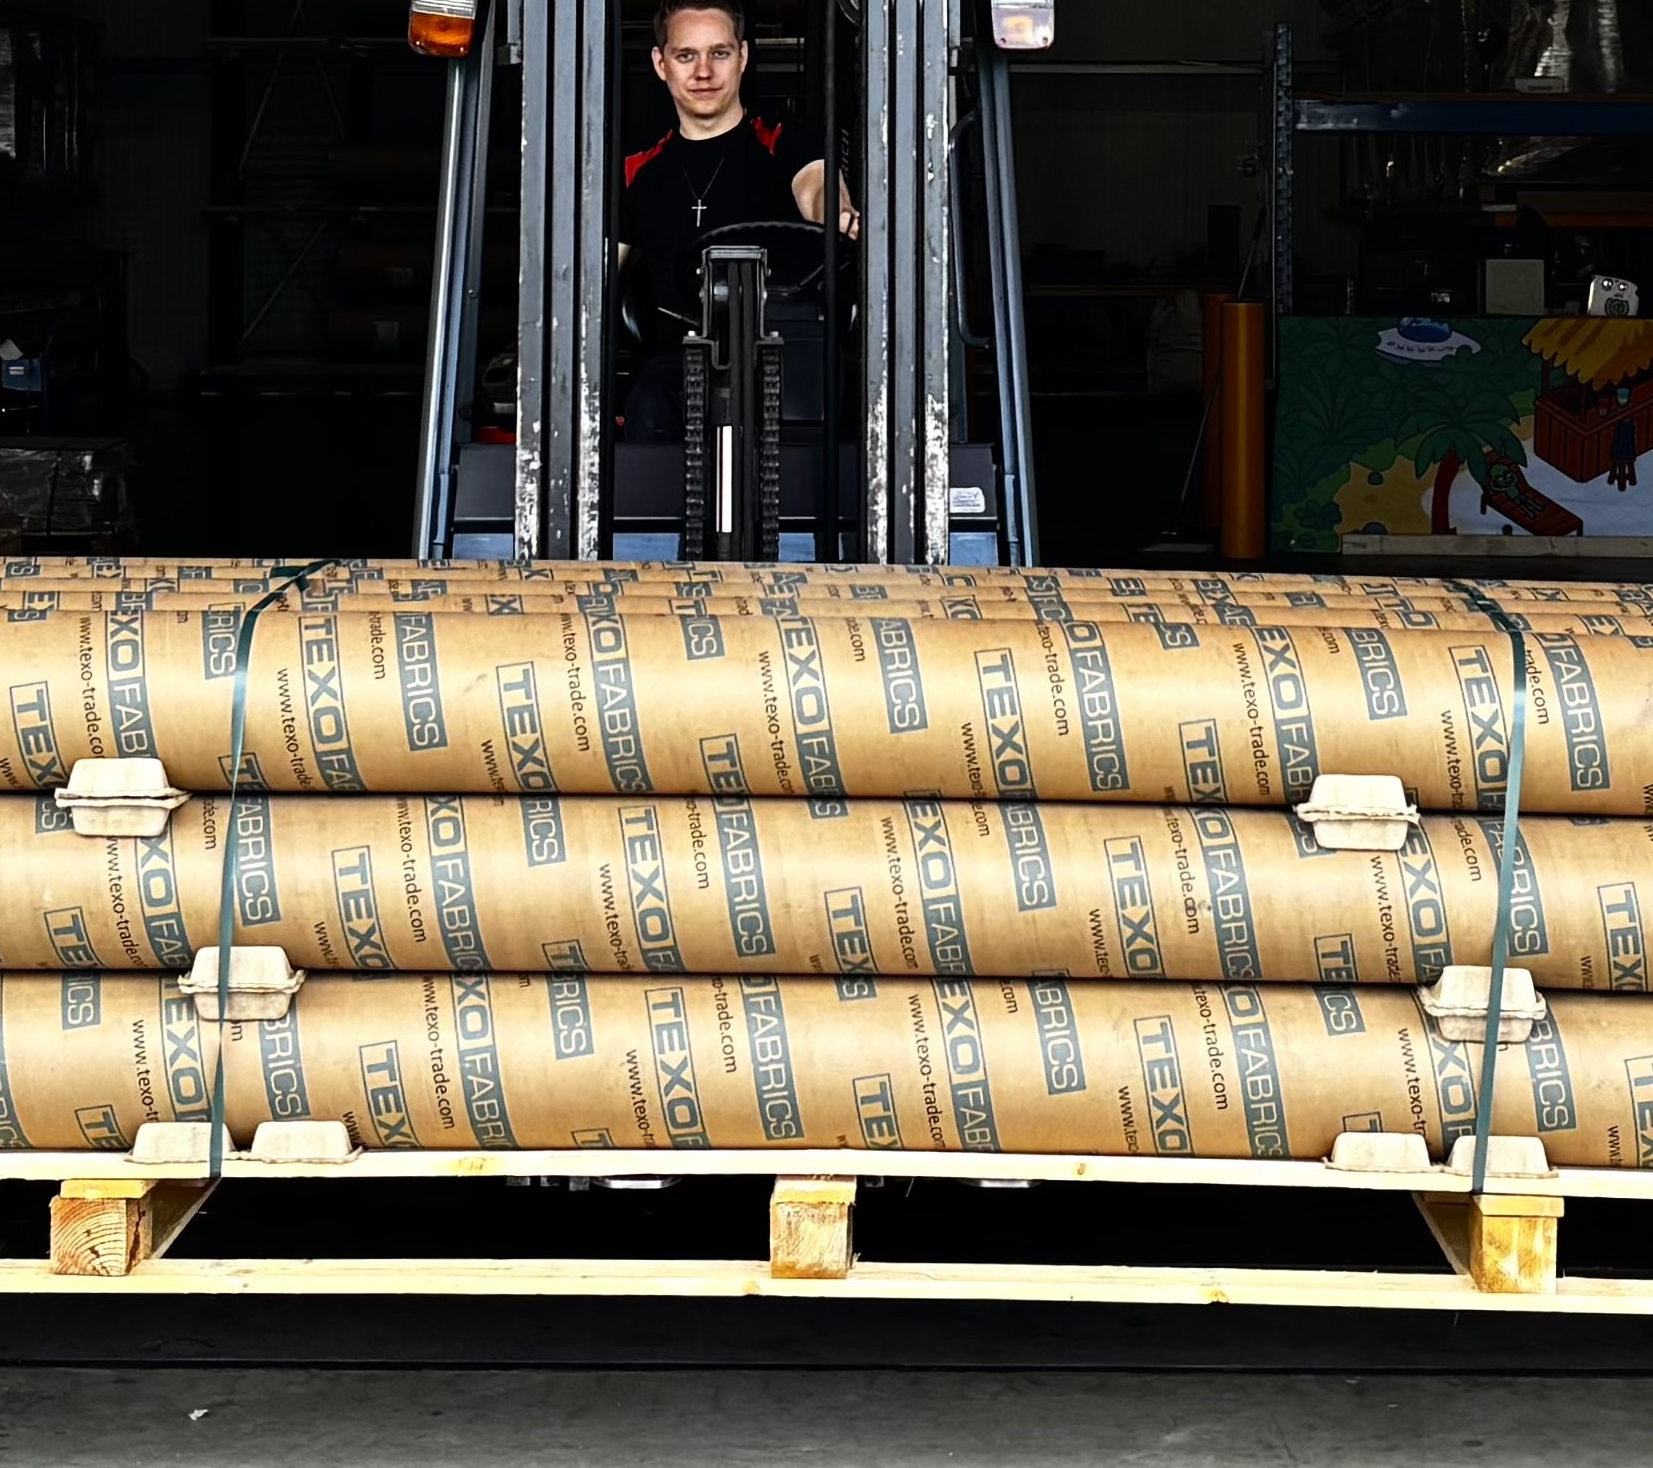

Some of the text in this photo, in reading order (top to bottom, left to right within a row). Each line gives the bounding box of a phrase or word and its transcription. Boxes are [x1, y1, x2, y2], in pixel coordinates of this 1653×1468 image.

[304, 618, 345, 743] TEXO
[502, 668, 552, 792] TEXO
[563, 614, 589, 751] ww.texo-trade.com
[881, 619, 919, 728] ABRICS
[982, 654, 1029, 786] TEXO
[1077, 649, 1122, 790] FABRICS
[1260, 628, 1303, 709] EXO
[1353, 629, 1400, 715] BRICS
[1458, 649, 1508, 782] TEXO
[1555, 640, 1603, 789] FABRICS
[15, 689, 69, 789] TEX
[1185, 731, 1224, 803] TEX
[237, 798, 273, 921] ABRICS
[527, 797, 558, 862] RICS
[625, 811, 670, 941] TEXO
[722, 813, 767, 954] FABRICS
[911, 801, 951, 890] EXO
[1401, 836, 1443, 936] EXO
[1112, 841, 1159, 972] TEXO
[163, 996, 207, 1106] EXO
[652, 992, 699, 1129] TEXO
[753, 995, 795, 1138] FABRICS
[936, 981, 980, 1074] EXO
[1142, 1022, 1188, 1154] TEXO
[1530, 1020, 1569, 1127] BRICS
